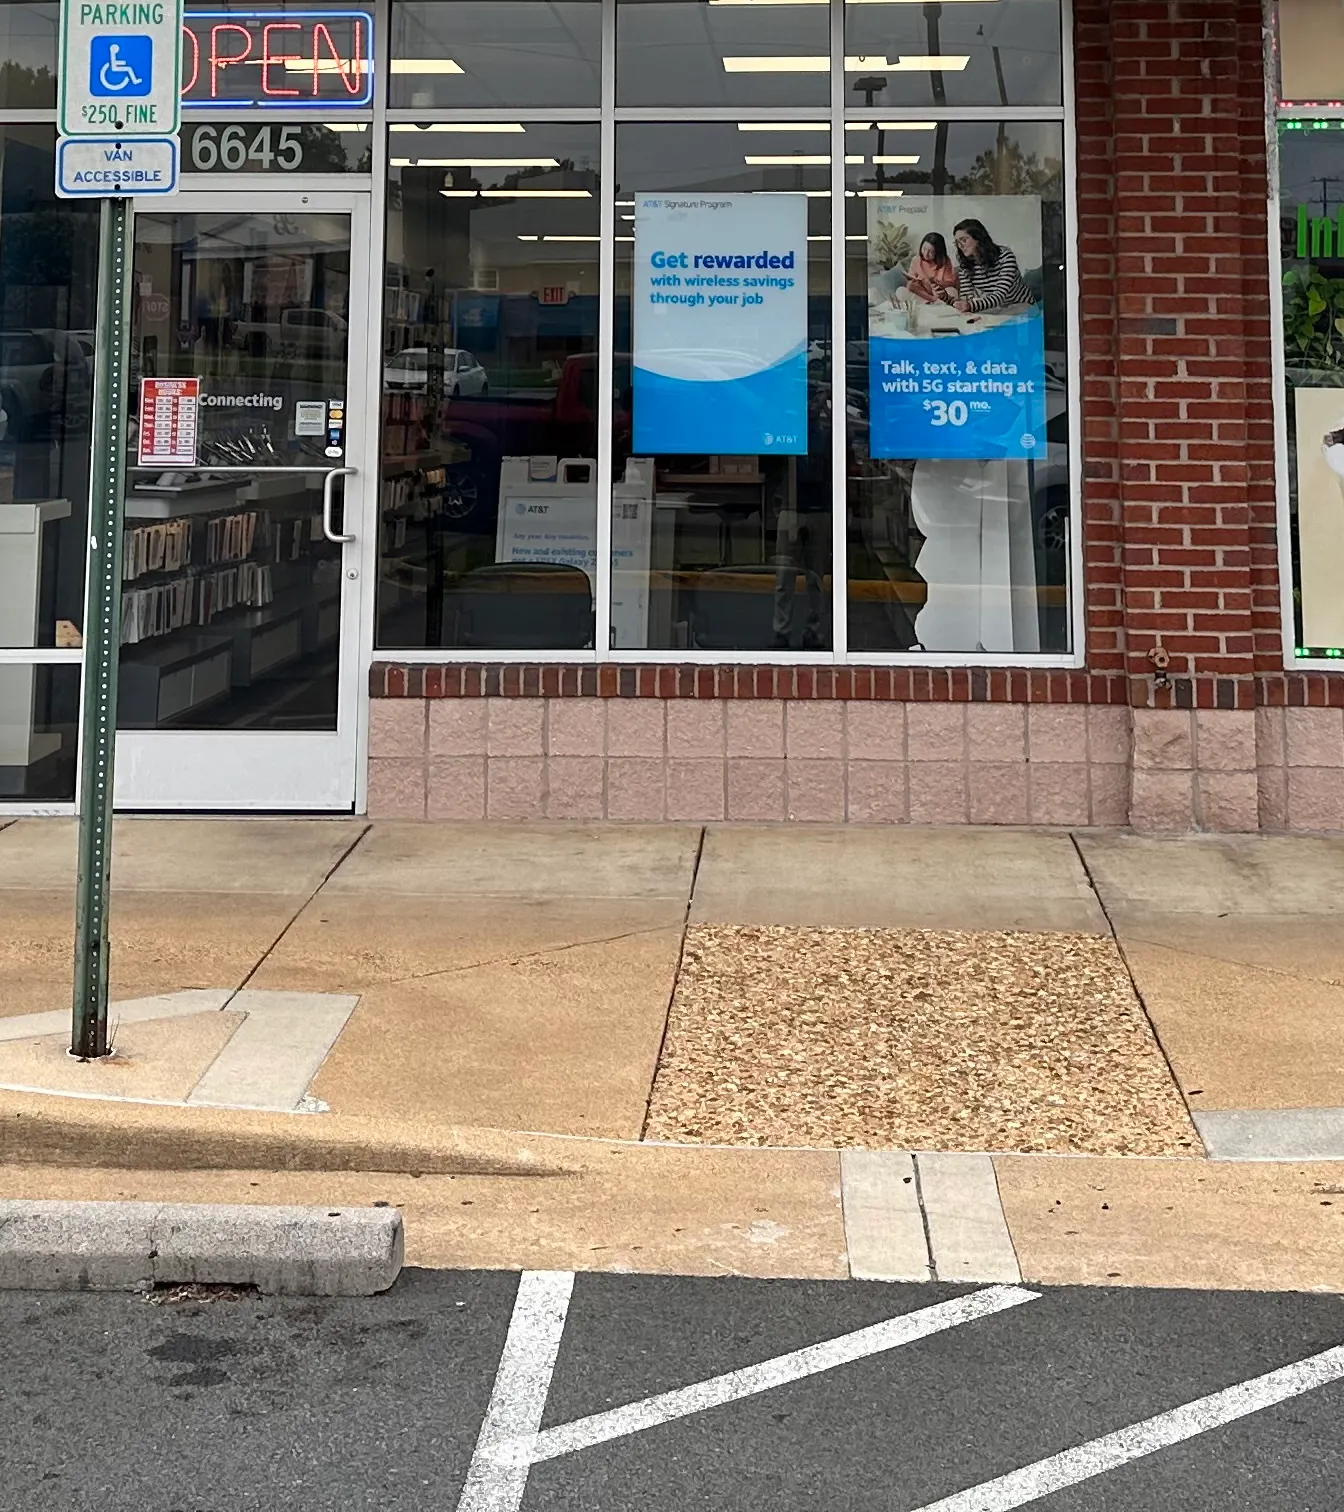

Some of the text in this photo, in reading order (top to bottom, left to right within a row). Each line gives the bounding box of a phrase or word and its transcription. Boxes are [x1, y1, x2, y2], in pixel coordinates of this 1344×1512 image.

[81, 4, 164, 25] PARKING
[81, 104, 157, 124] $250 FINE
[191, 125, 303, 170] 6645
[104, 150, 133, 162] VAN
[73, 170, 161, 183] ACCESSIBLE
[643, 200, 732, 210] AT&T Signature Program
[650, 251, 794, 269] Get rewarded
[650, 274, 795, 290] with wireless savings
[543, 287, 564, 303] EXIT
[650, 292, 764, 307] through your job
[881, 360, 1017, 376] Talk, text, & data
[882, 379, 1034, 397] with 5G starting at
[197, 393, 283, 411] Connecting
[923, 398, 991, 426] $30 mo.
[776, 434, 798, 444] AT&T
[528, 505, 549, 514] AT&T
[512, 547, 531, 555] New
[533, 547, 549, 555] and
[551, 548, 586, 557] existing
